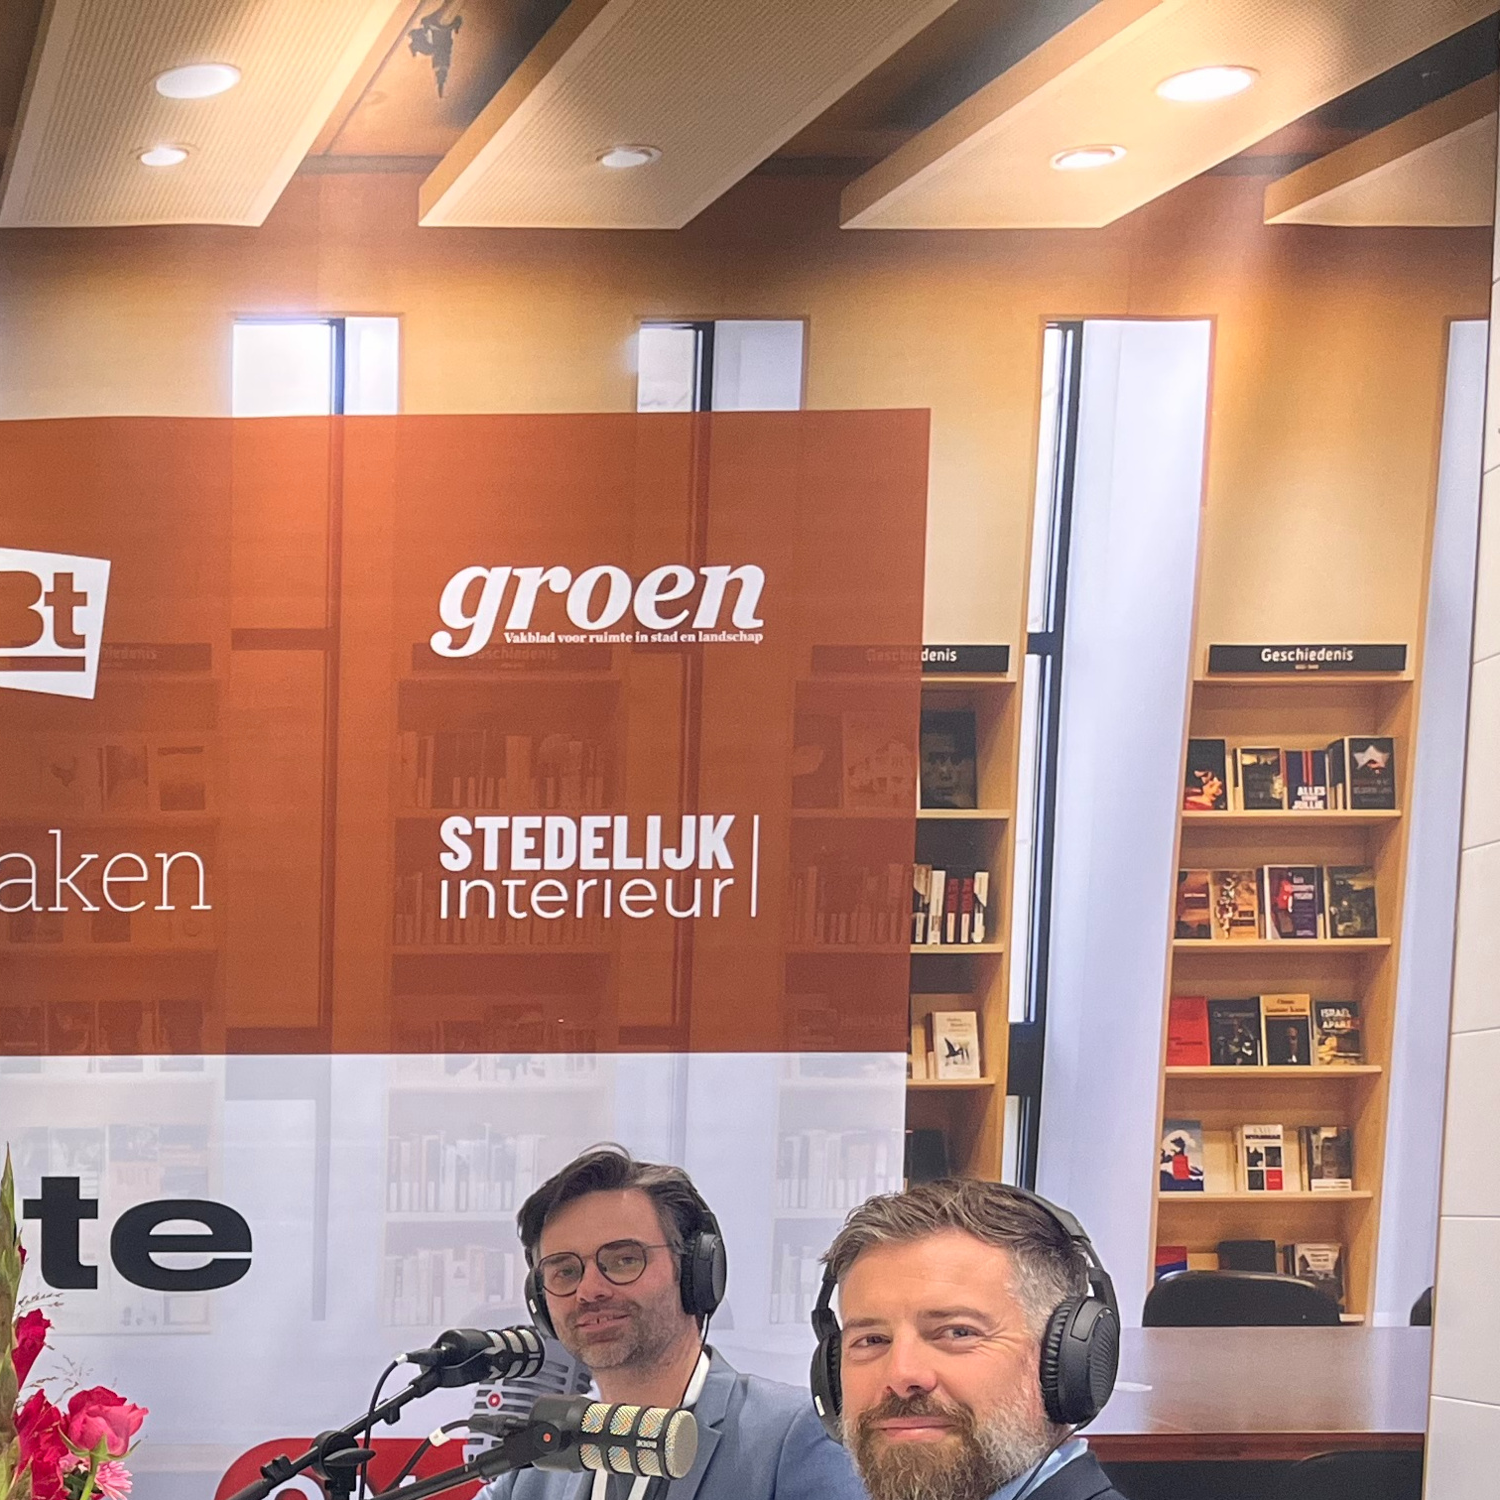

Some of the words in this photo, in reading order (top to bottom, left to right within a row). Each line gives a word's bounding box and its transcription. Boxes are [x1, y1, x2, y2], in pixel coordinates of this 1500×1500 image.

[430, 564, 765, 658] groen
[504, 631, 556, 644] Vakblad
[558, 633, 587, 644] voor
[589, 631, 632, 644] ruimte
[635, 631, 648, 644] in
[651, 631, 678, 644] stad
[680, 633, 696, 644] en
[698, 631, 764, 645] landschap
[1260, 646, 1355, 662] Geschiedenis
[440, 814, 735, 872] STEDELIJK
[440, 876, 735, 920] interieur
